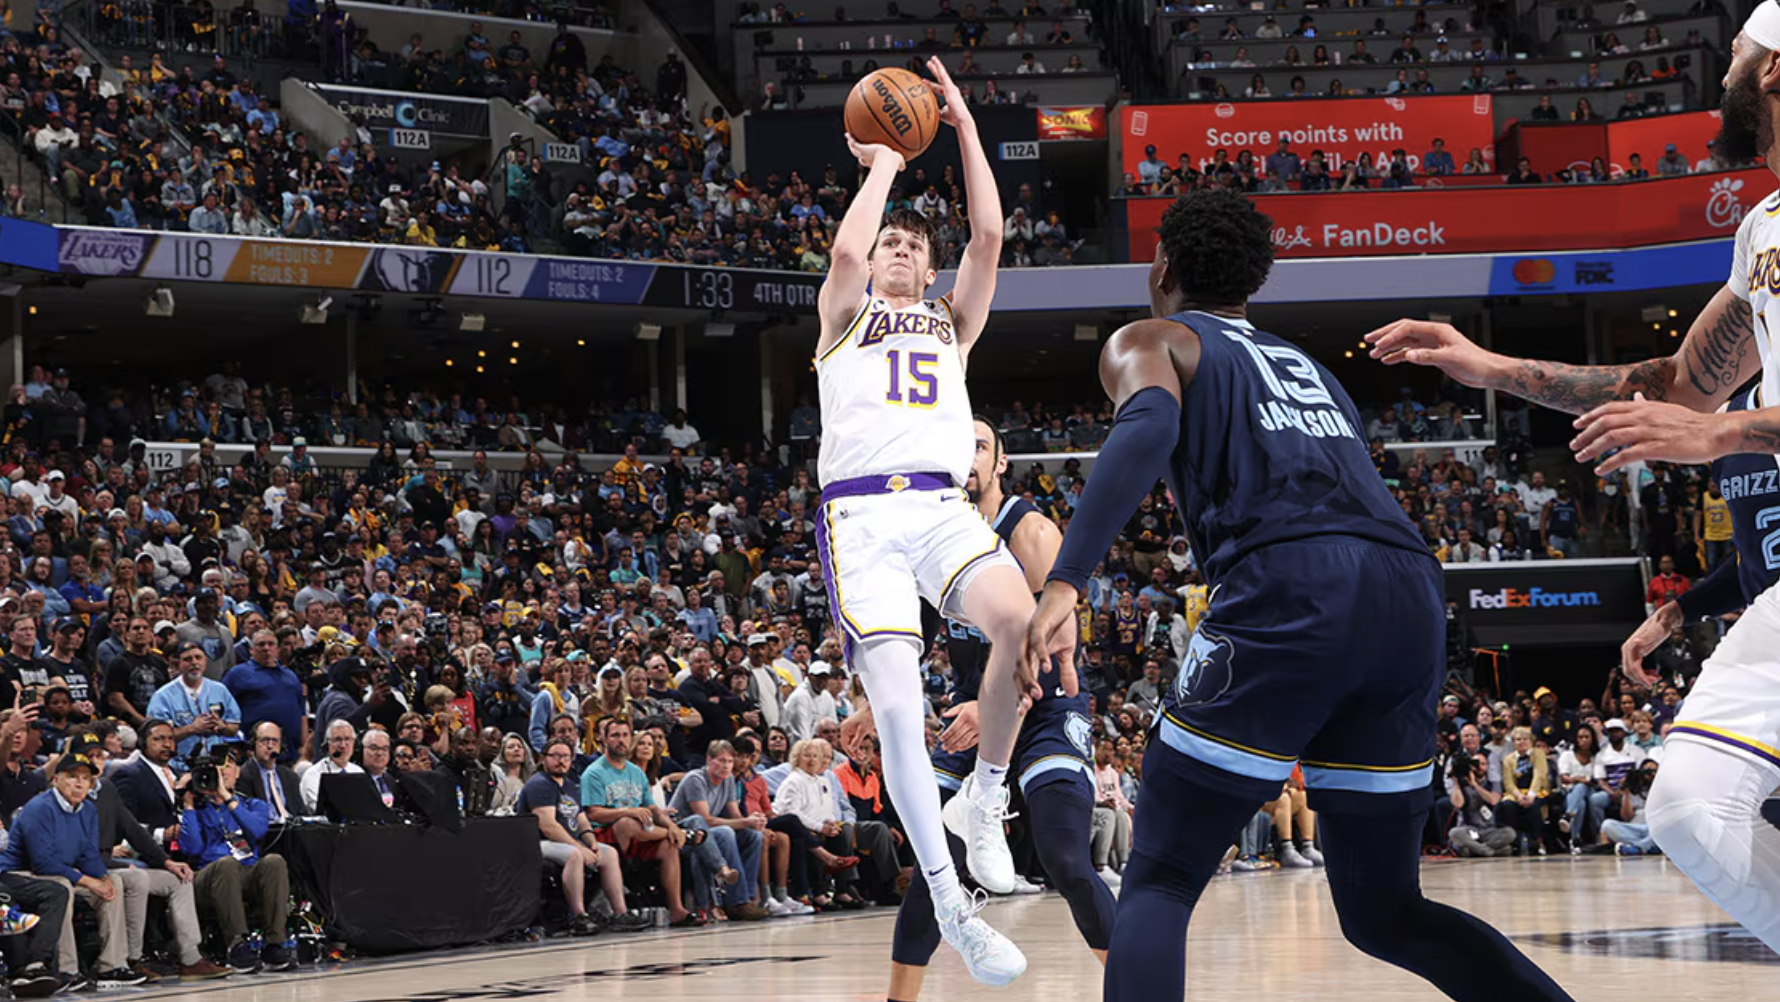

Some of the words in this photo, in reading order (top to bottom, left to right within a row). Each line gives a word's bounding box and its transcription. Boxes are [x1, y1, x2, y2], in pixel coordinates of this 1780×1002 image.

[418, 108, 451, 123] Clinic
[873, 79, 912, 137] Wilson
[1042, 113, 1091, 127] SONIC
[396, 131, 427, 146] 112A
[1206, 128, 1272, 147] Score
[1279, 125, 1348, 146] points
[1355, 121, 1404, 142] with
[548, 145, 578, 160] 112A
[1006, 144, 1036, 157] 112A
[1376, 151, 1420, 173] Ap
[1323, 221, 1446, 247] FanDeck
[63, 235, 140, 267] LAKERS
[174, 239, 213, 278] 118
[476, 257, 512, 294] 112
[615, 268, 624, 283] 2
[591, 284, 600, 299] 4
[684, 271, 733, 308] 1:33
[754, 283, 781, 304] 4TH
[786, 284, 816, 307] QTR
[857, 310, 954, 348] LAKERS
[885, 349, 939, 410] 15
[1221, 329, 1339, 410] 13
[149, 452, 174, 468] 112
[1464, 449, 1485, 463] 11
[1721, 469, 1780, 501] GRIZZ
[1469, 587, 1600, 609] FedExForum
